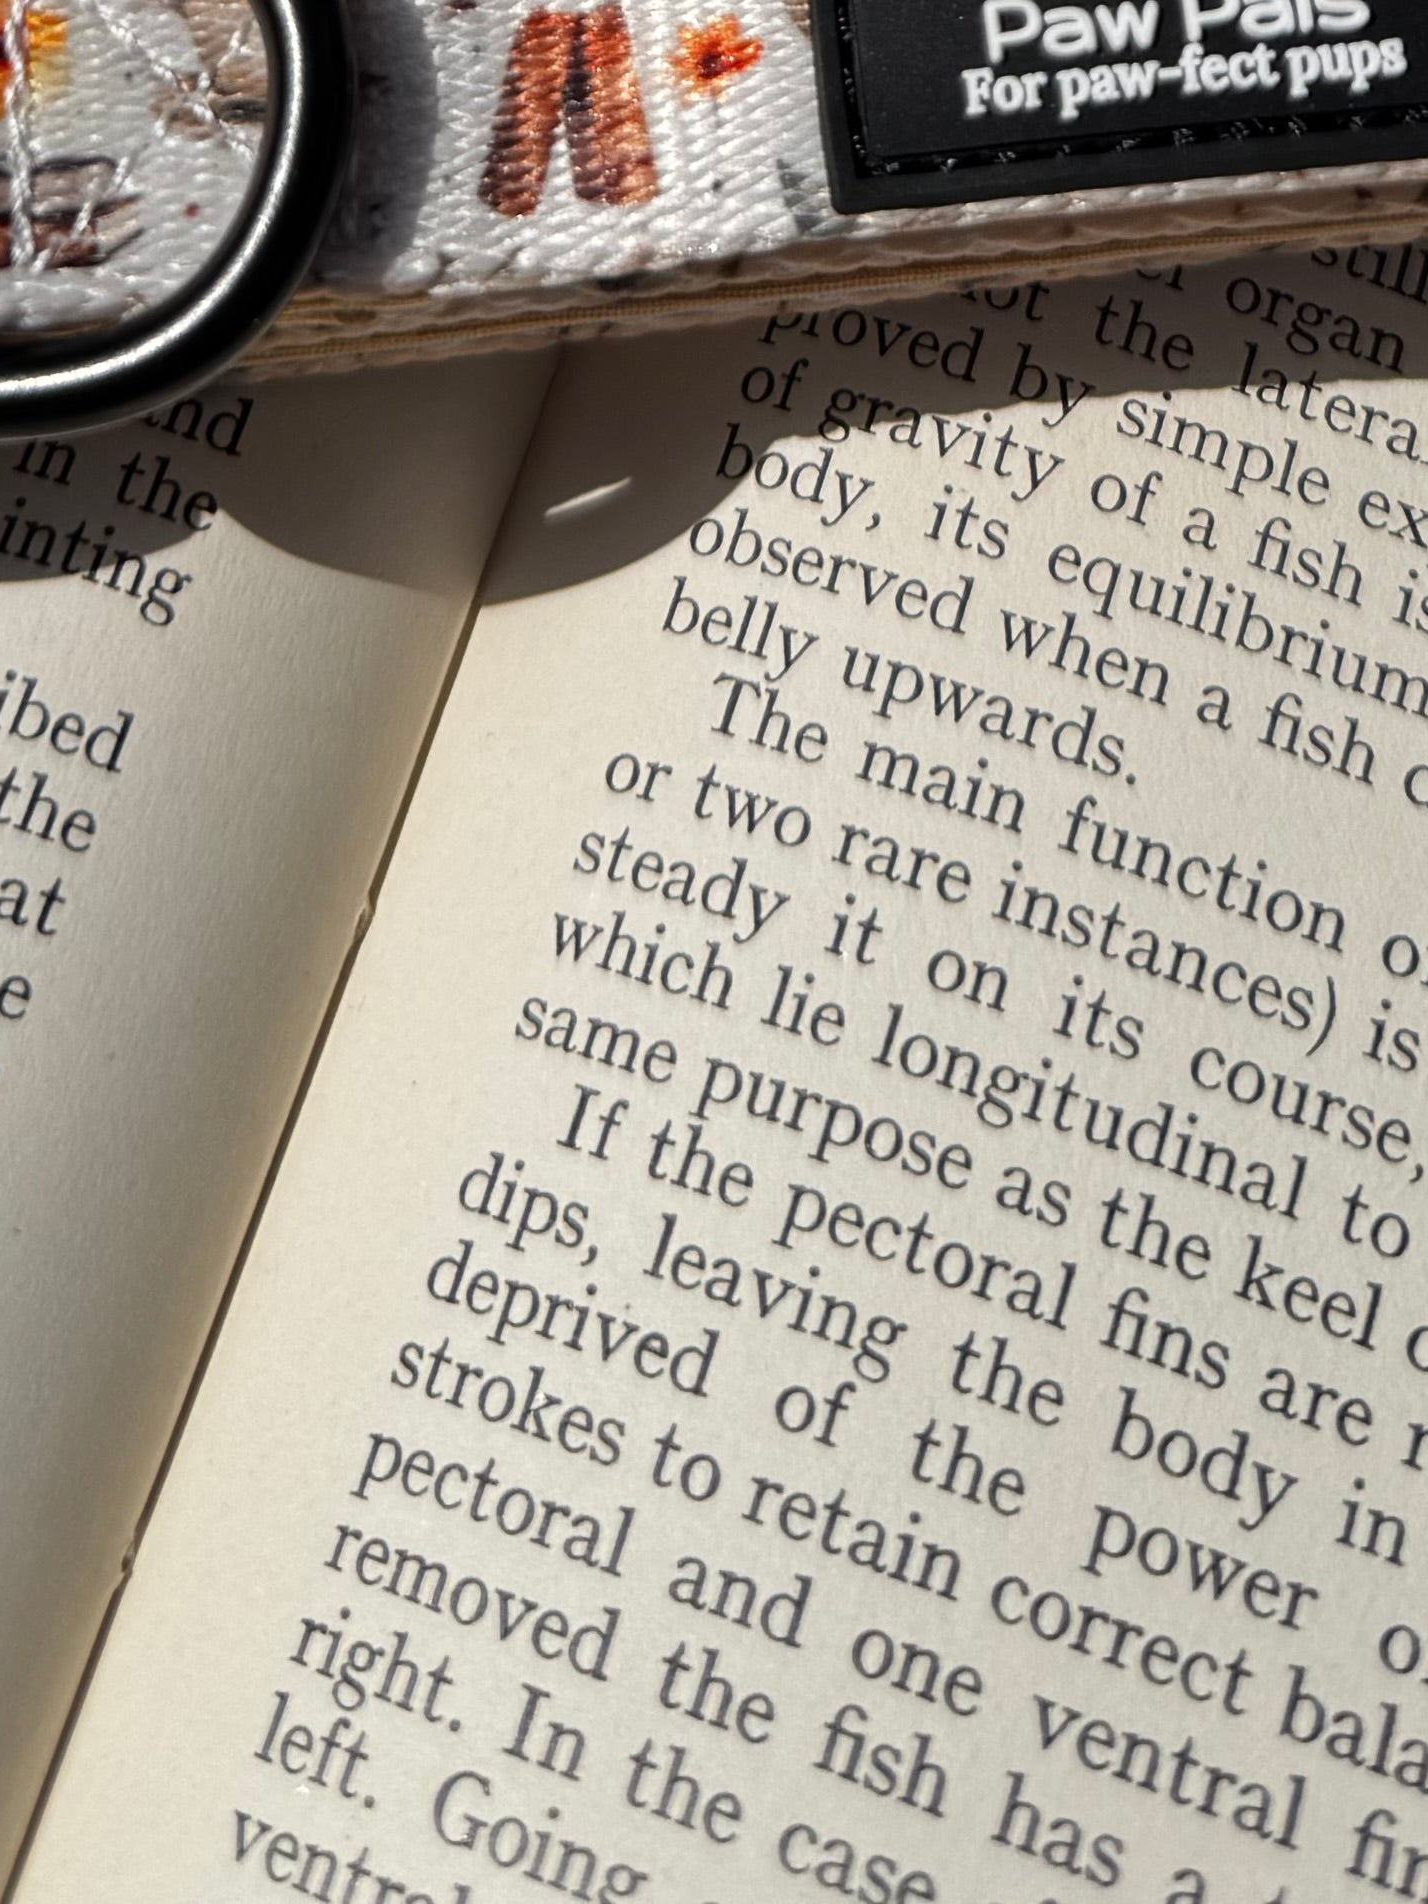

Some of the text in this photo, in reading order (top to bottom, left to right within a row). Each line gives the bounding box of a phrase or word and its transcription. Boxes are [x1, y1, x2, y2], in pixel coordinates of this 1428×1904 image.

[961, 36, 1408, 121] For paw-fect pups
[711, 672, 828, 764] The
[855, 741, 1024, 835] main
[1058, 795, 1344, 955] function
[573, 826, 790, 945] steady
[824, 893, 883, 966] it
[927, 950, 1007, 1013] on
[1053, 975, 1143, 1060] its
[1191, 1048, 1424, 1184] course,
[556, 1084, 629, 1161] If
[648, 1120, 753, 1207] the
[772, 1184, 1077, 1331] pectoral
[1100, 1287, 1229, 1390] fins
[1259, 1368, 1372, 1447] are
[350, 1433, 1306, 1850] pectoral and one ventral
